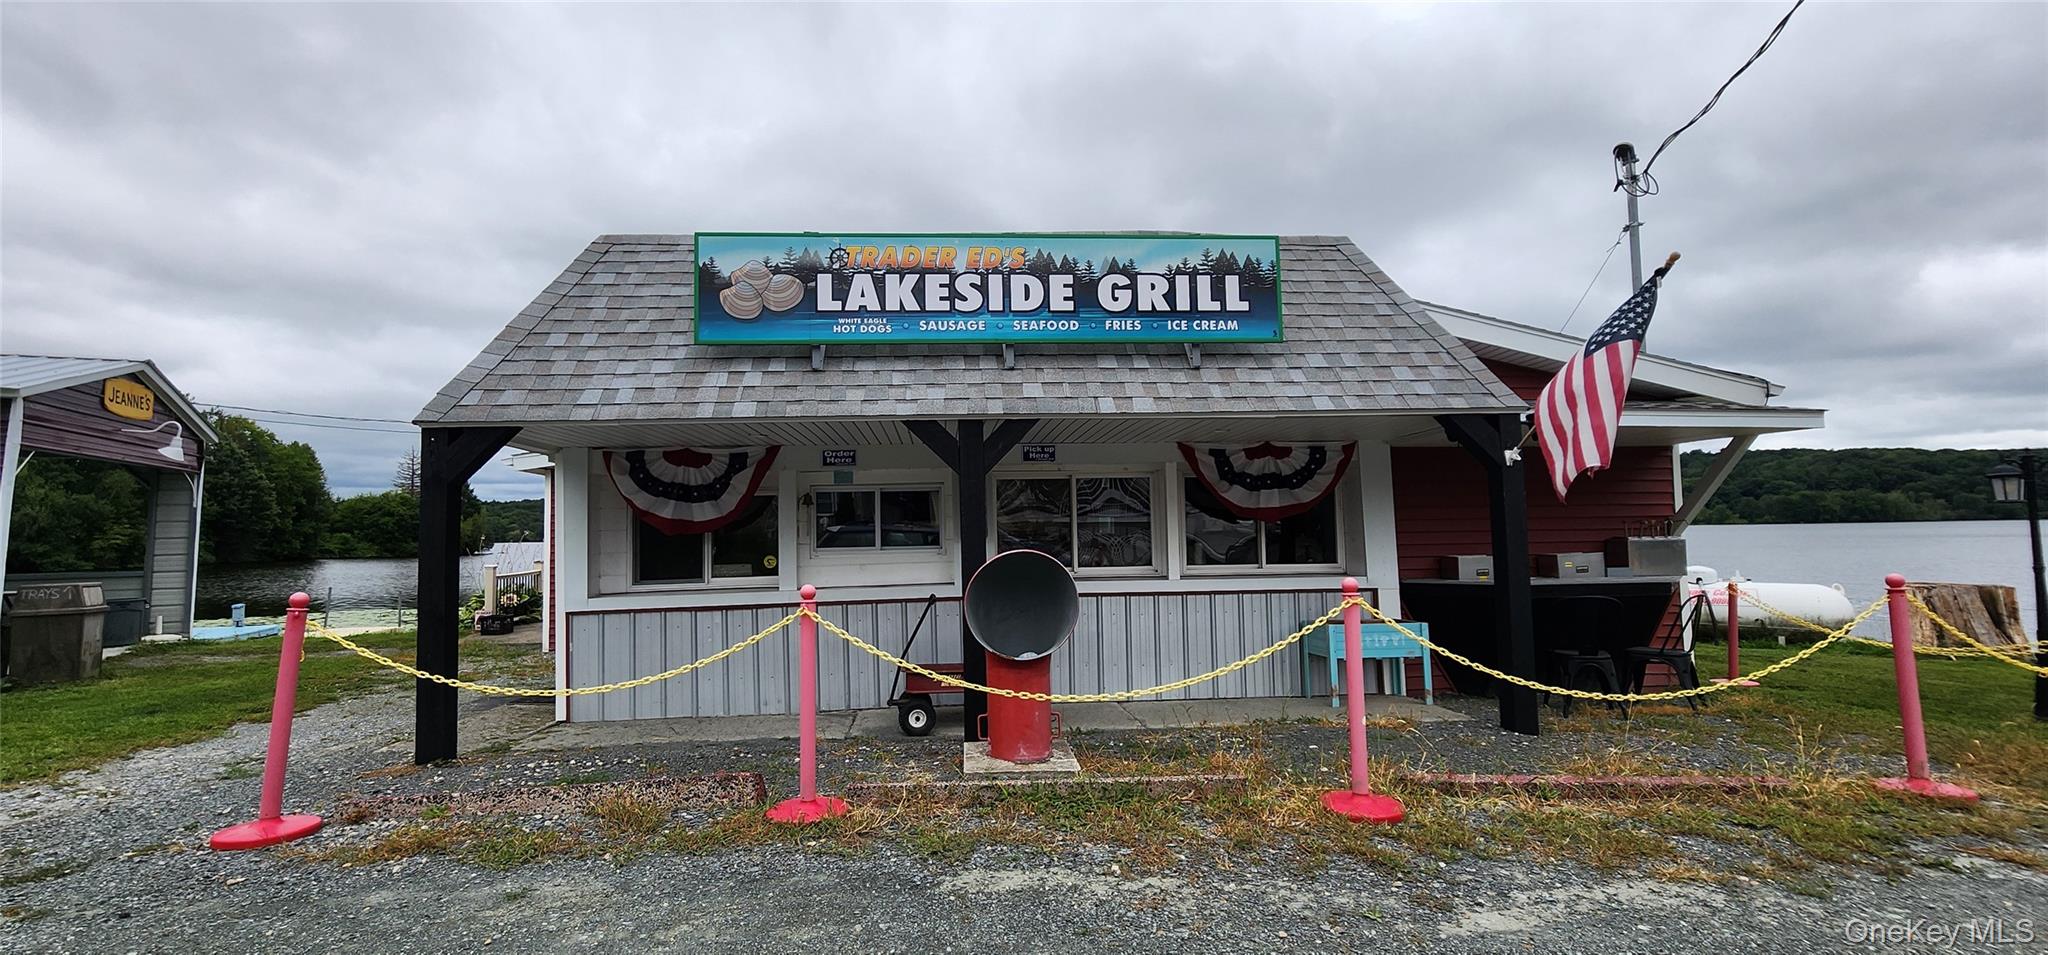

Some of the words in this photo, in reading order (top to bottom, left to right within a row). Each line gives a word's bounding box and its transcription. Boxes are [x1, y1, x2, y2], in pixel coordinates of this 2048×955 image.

[845, 245, 957, 269] TRADER
[965, 246, 1027, 269] ED'S
[816, 272, 1075, 312] LAKESIDE
[1097, 273, 1250, 312] GRILL
[833, 324, 858, 333] HOT
[861, 324, 892, 333] DOGS
[919, 319, 986, 331] SAUSAGE
[1013, 320, 1079, 331] SEAFOOD
[1105, 320, 1142, 331] FRIES
[1167, 320, 1188, 331] ICE
[1193, 320, 1239, 331] CREAM
[108, 386, 151, 411] JEANNE'S
[22, 587, 60, 600] TRAYS
